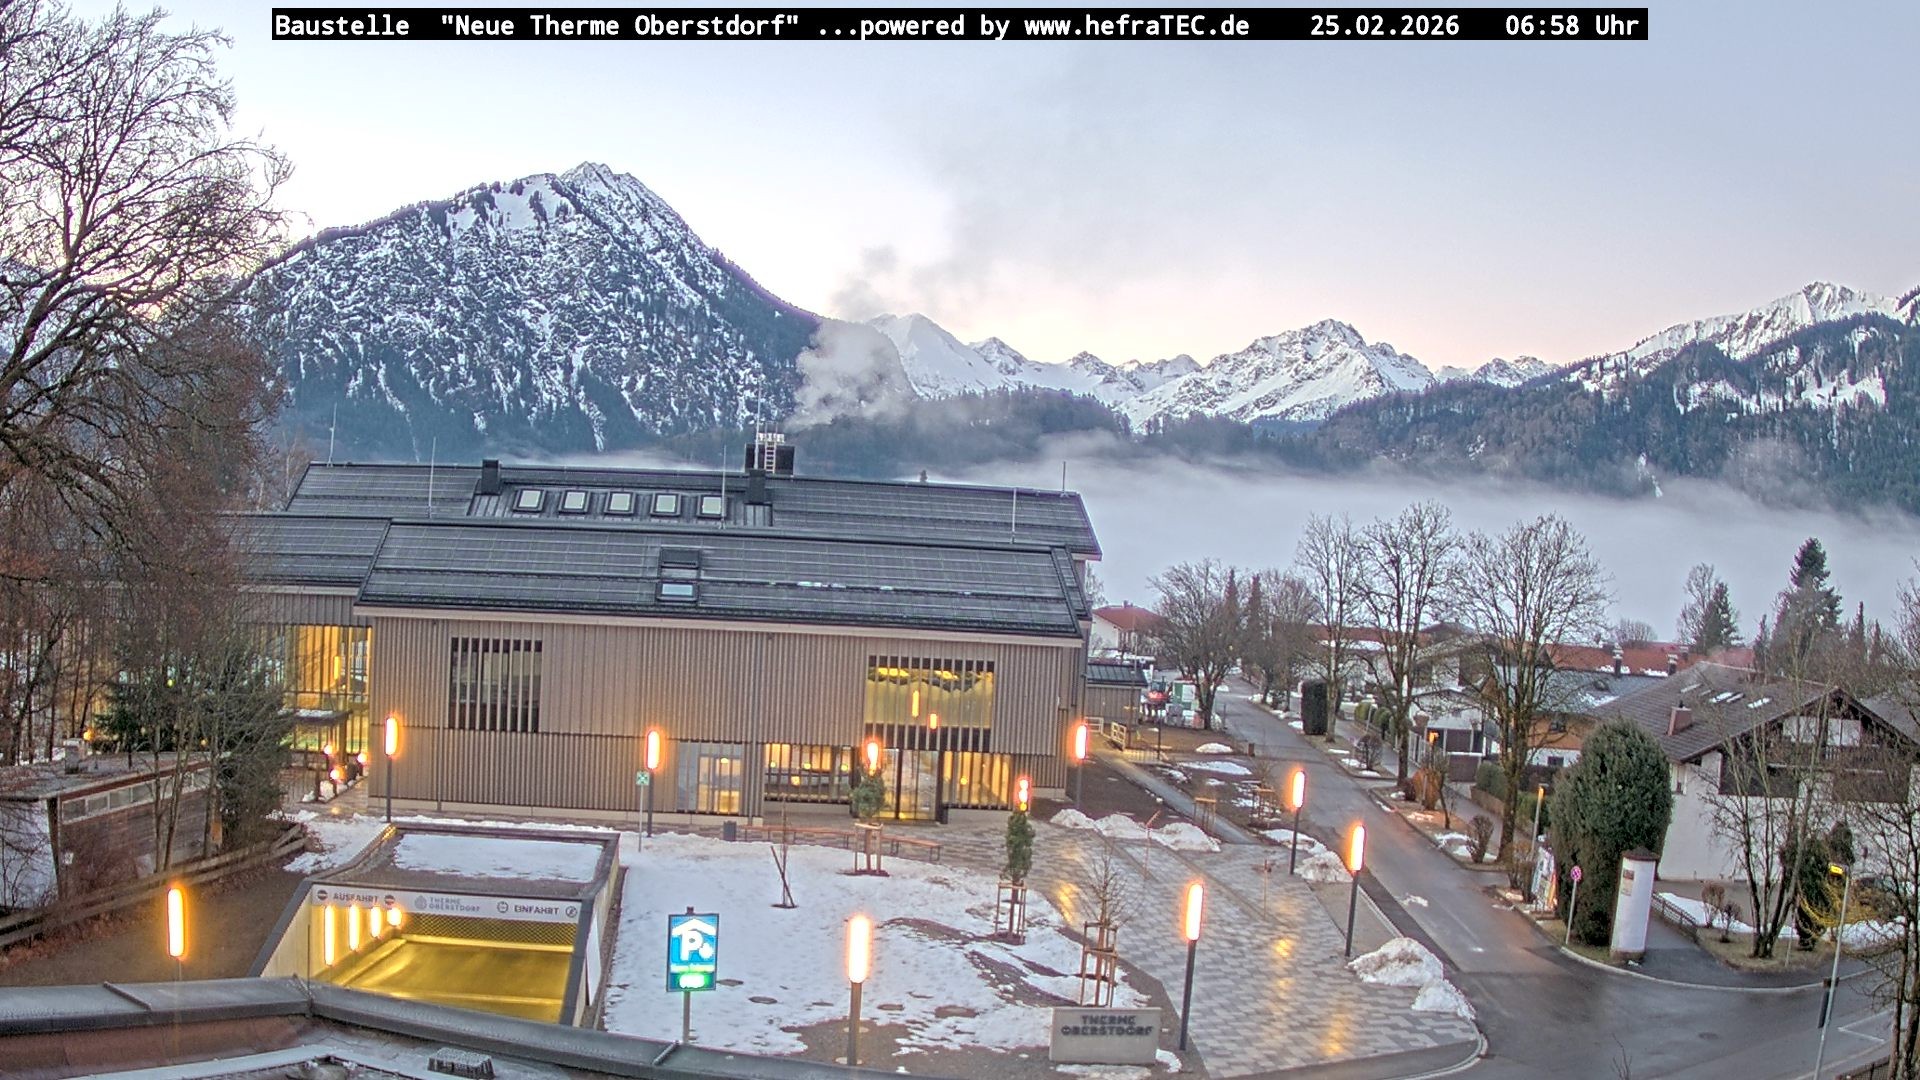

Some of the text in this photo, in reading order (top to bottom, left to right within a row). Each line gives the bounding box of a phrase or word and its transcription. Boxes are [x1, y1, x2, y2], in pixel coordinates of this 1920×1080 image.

[333, 892, 378, 903] AUSFAHRT
[514, 904, 559, 915] EINFAHRT
[1081, 1014, 1136, 1026] THERME
[1061, 1025, 1153, 1036] OBERSTDORF
